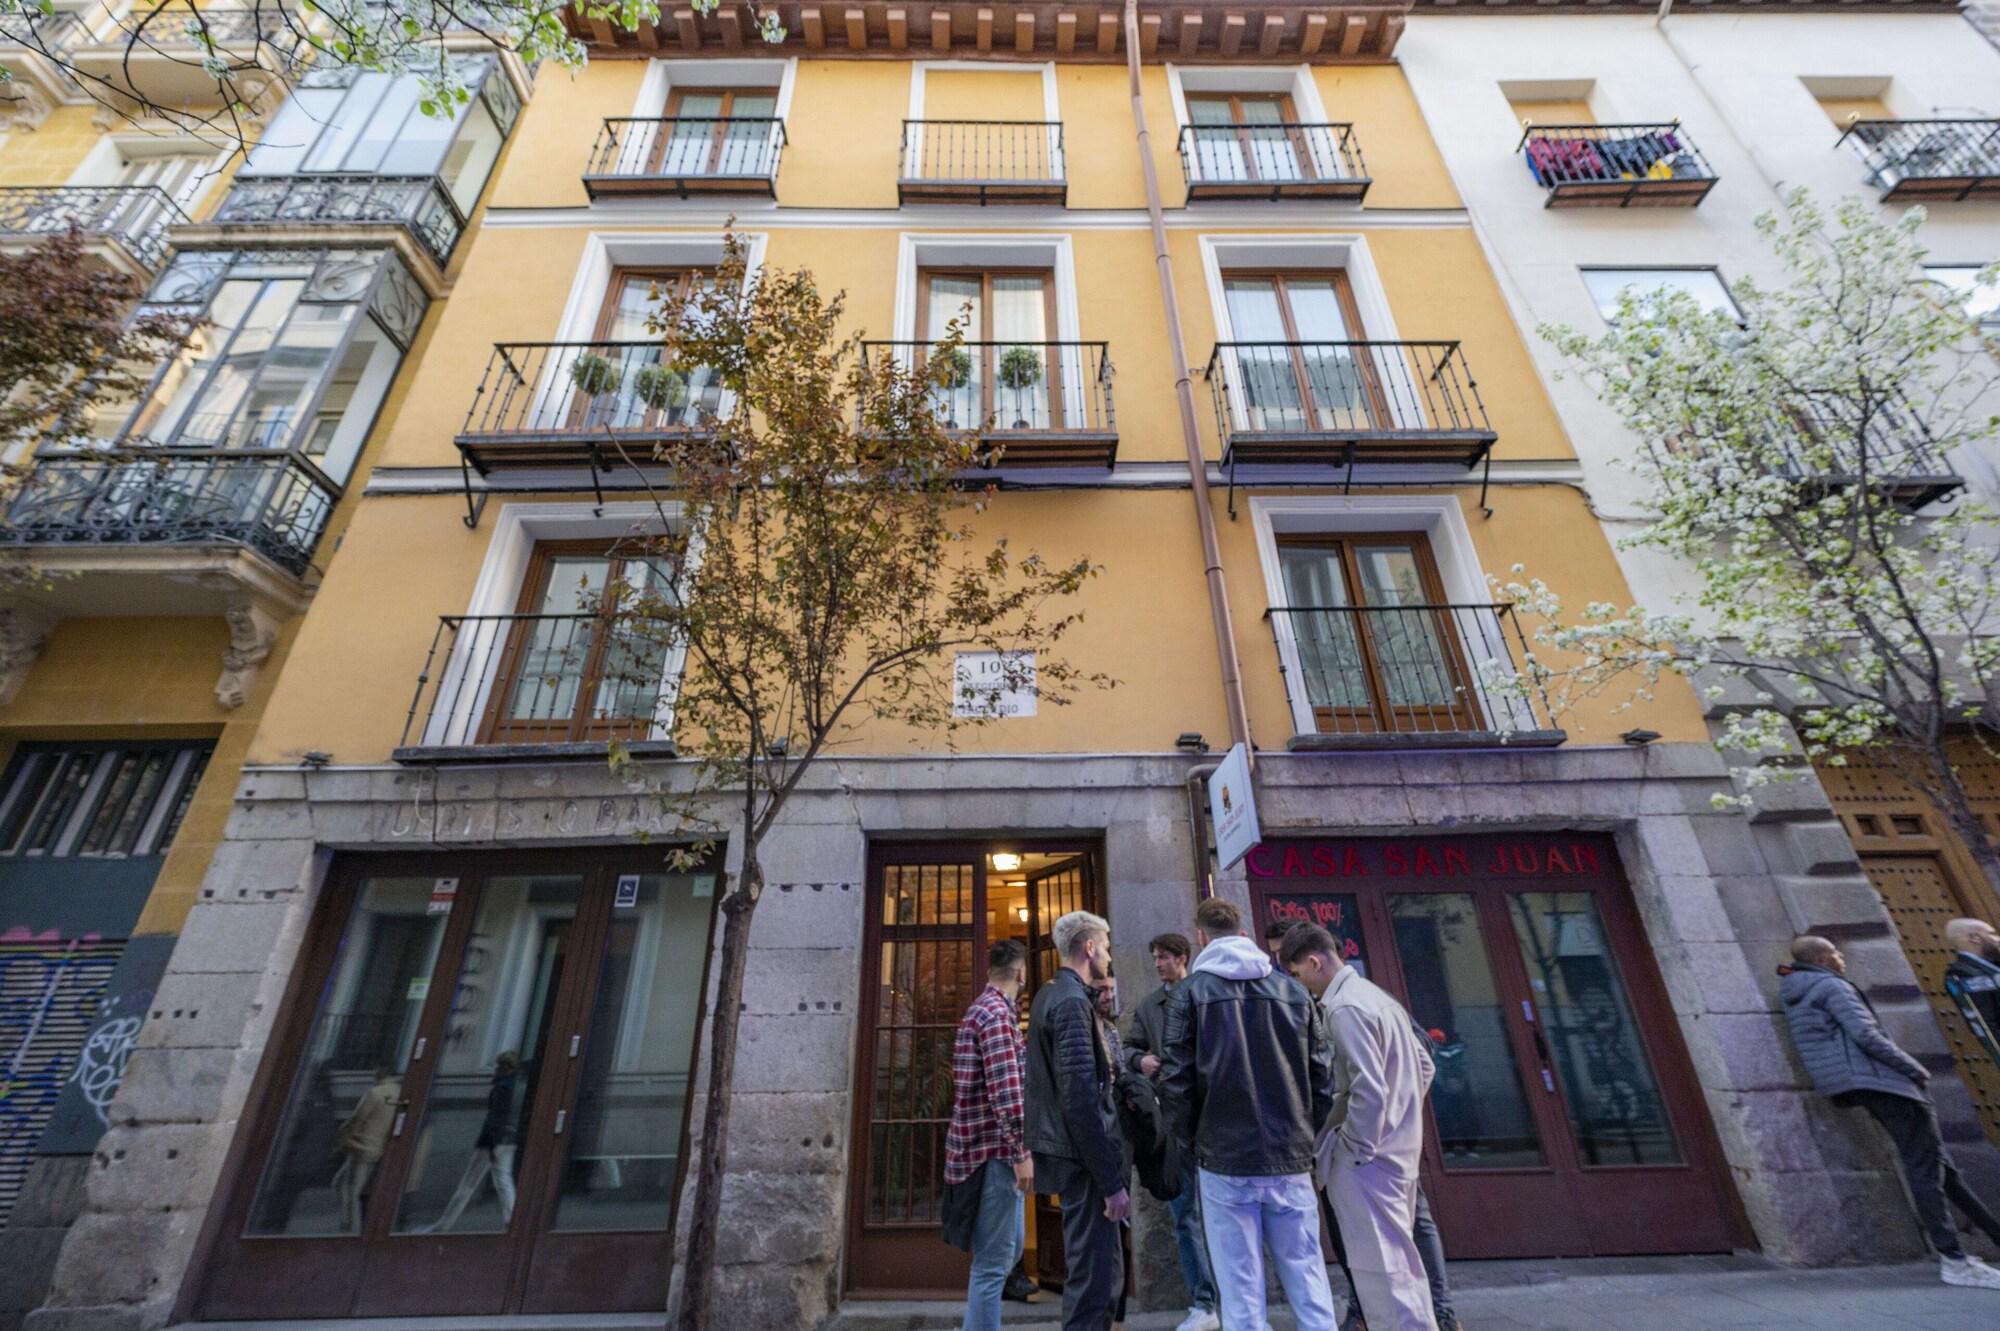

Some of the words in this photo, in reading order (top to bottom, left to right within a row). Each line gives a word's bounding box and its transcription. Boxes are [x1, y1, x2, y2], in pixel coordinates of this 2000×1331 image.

[1246, 845, 1370, 878] CASA
[1384, 844, 1472, 877] SAN
[1489, 843, 1601, 876] JUAN
